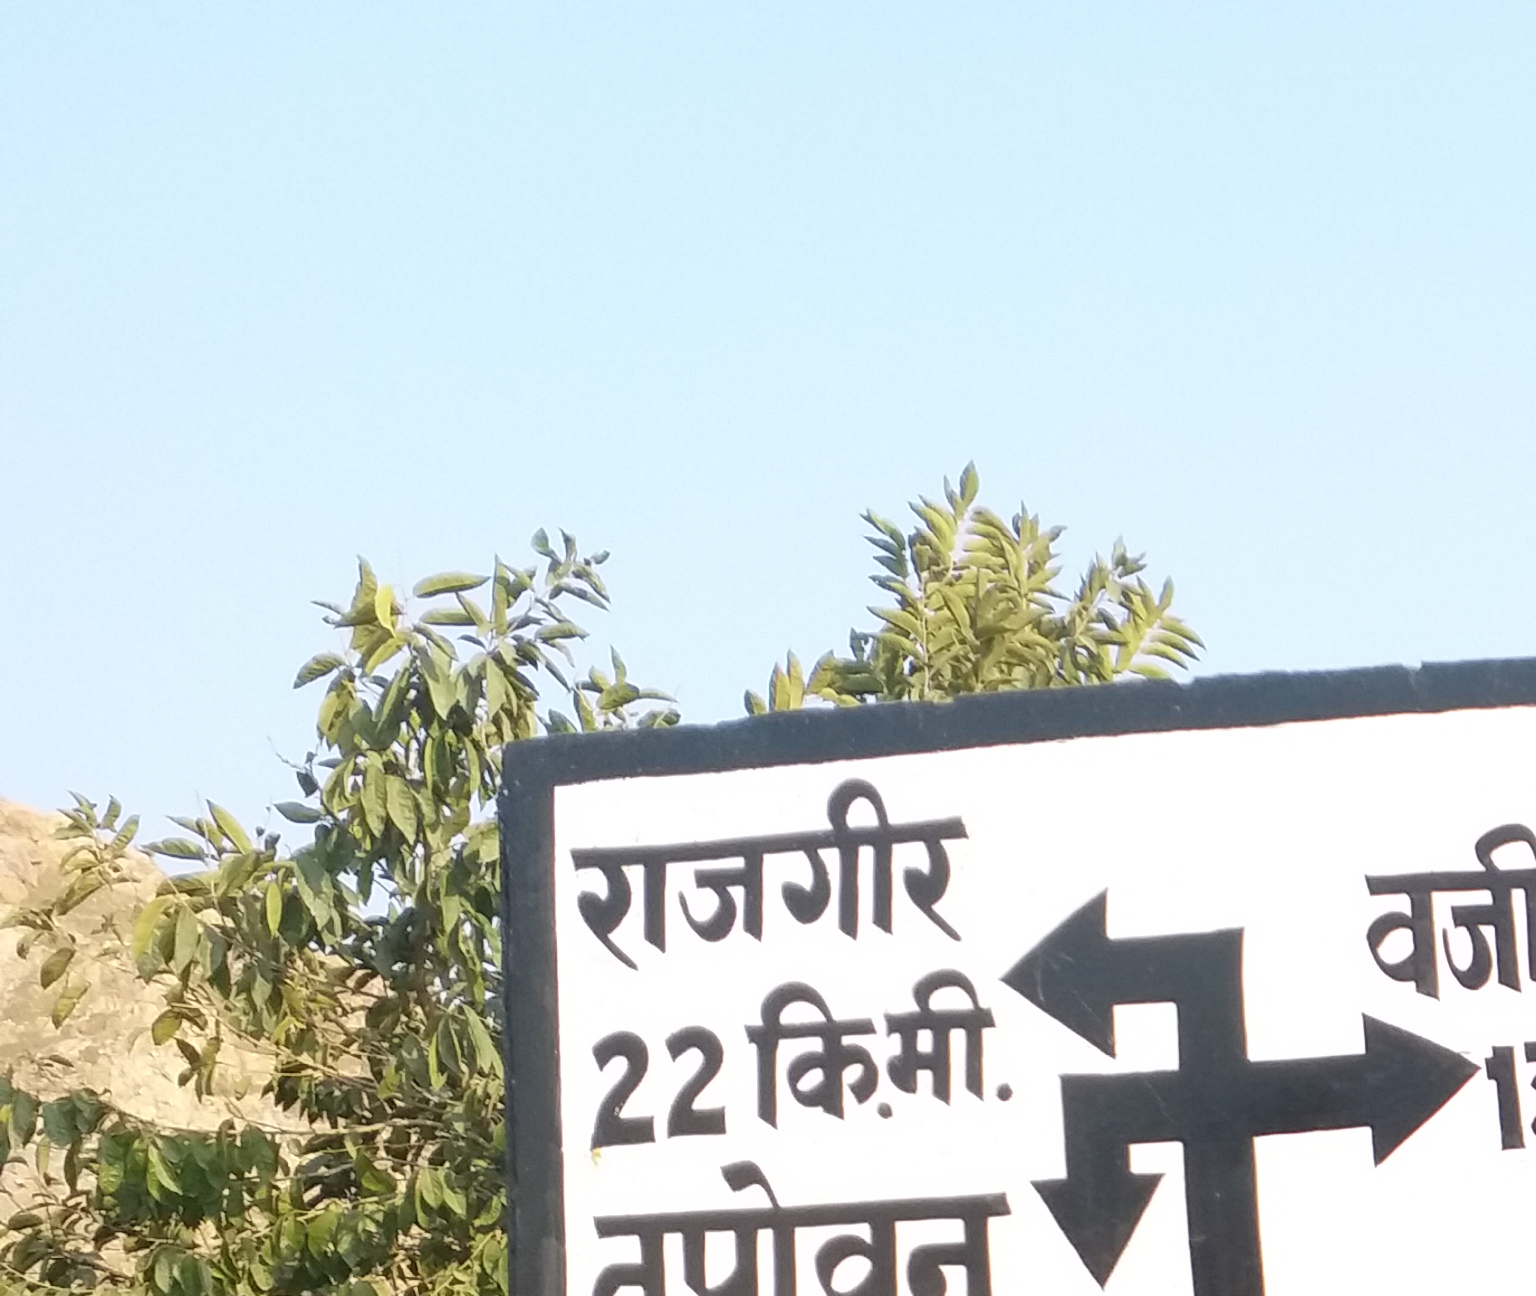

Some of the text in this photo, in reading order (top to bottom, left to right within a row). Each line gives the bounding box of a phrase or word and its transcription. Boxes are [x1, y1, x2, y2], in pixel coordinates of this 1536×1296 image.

[571, 779, 969, 969] राजगीर
[591, 967, 1012, 1151] 22 कि.मी.
